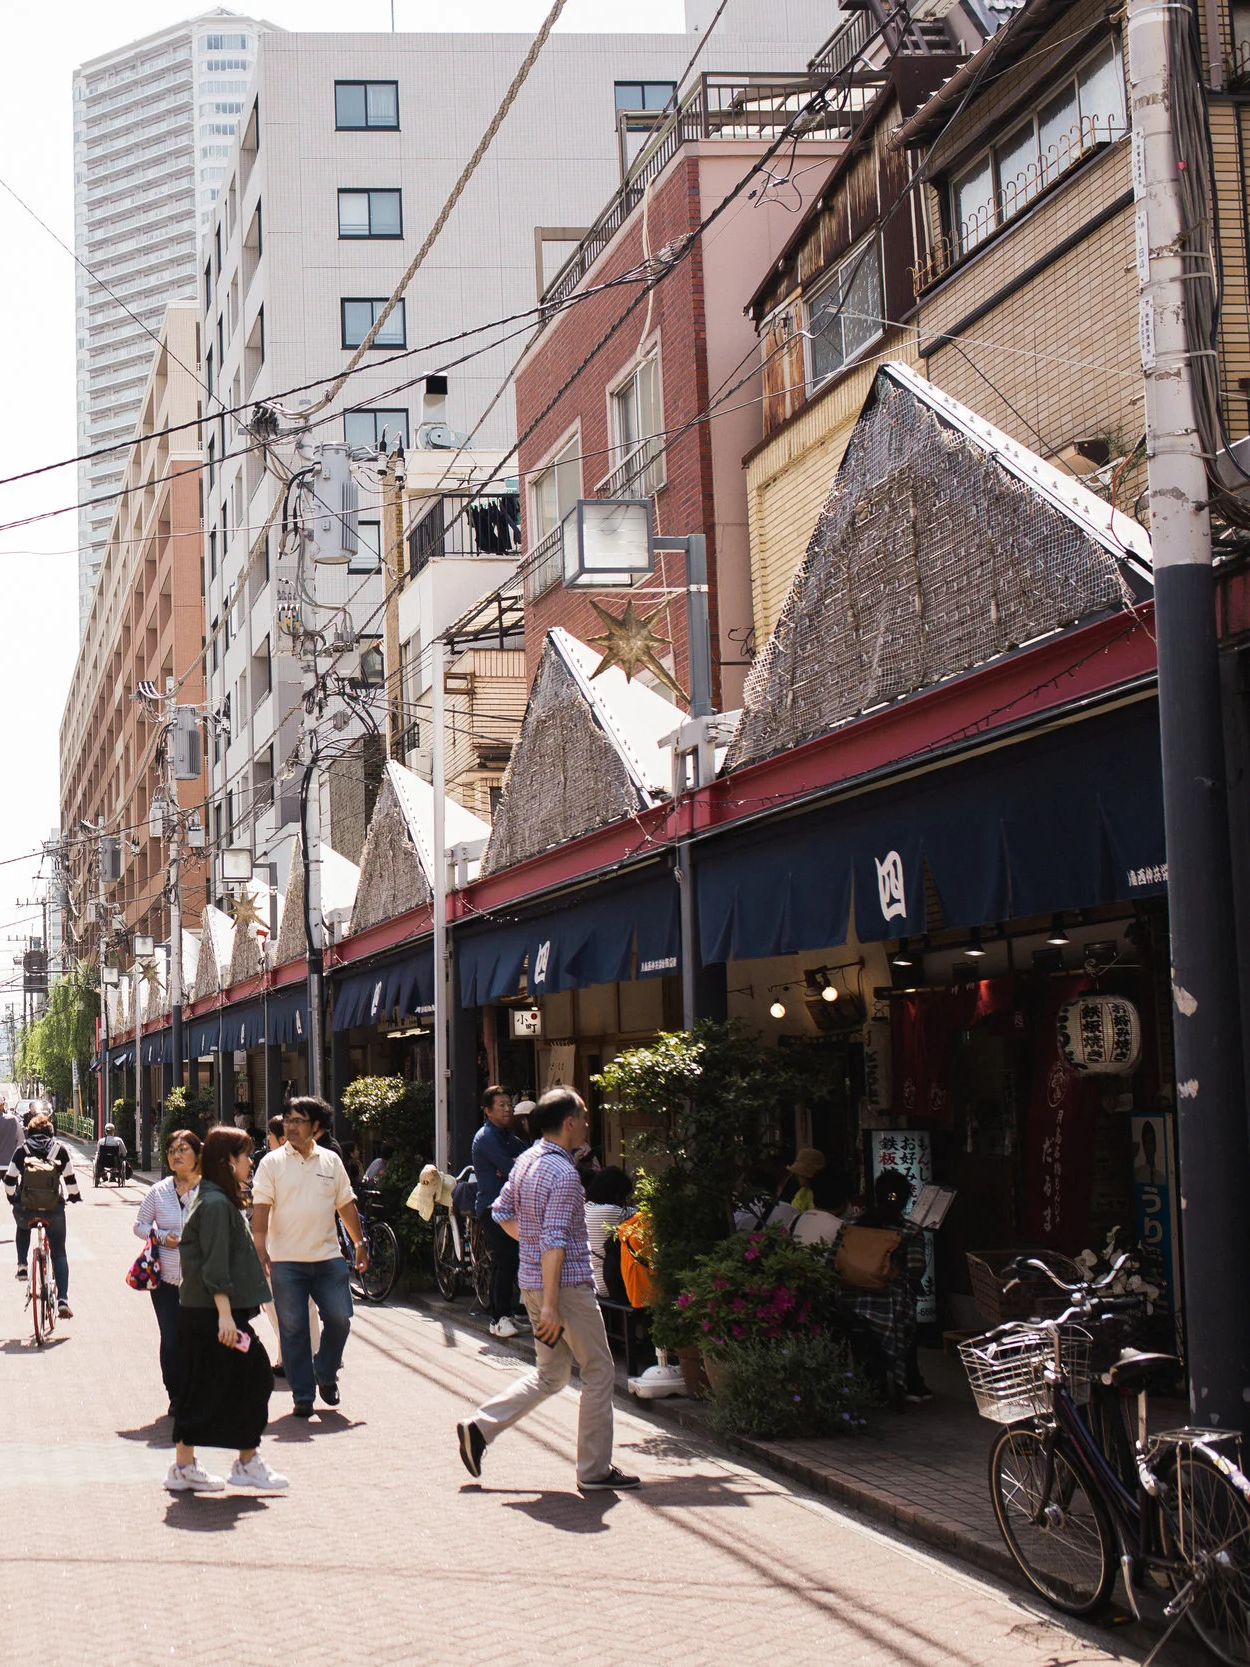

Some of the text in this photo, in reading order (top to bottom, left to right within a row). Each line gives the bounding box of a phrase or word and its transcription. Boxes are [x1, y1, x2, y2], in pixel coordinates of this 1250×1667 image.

[874, 850, 907, 922] 四
[516, 1013, 538, 1034] 小町
[1081, 1005, 1104, 1062] 鉄板焼き
[917, 1135, 931, 1183] もんじ
